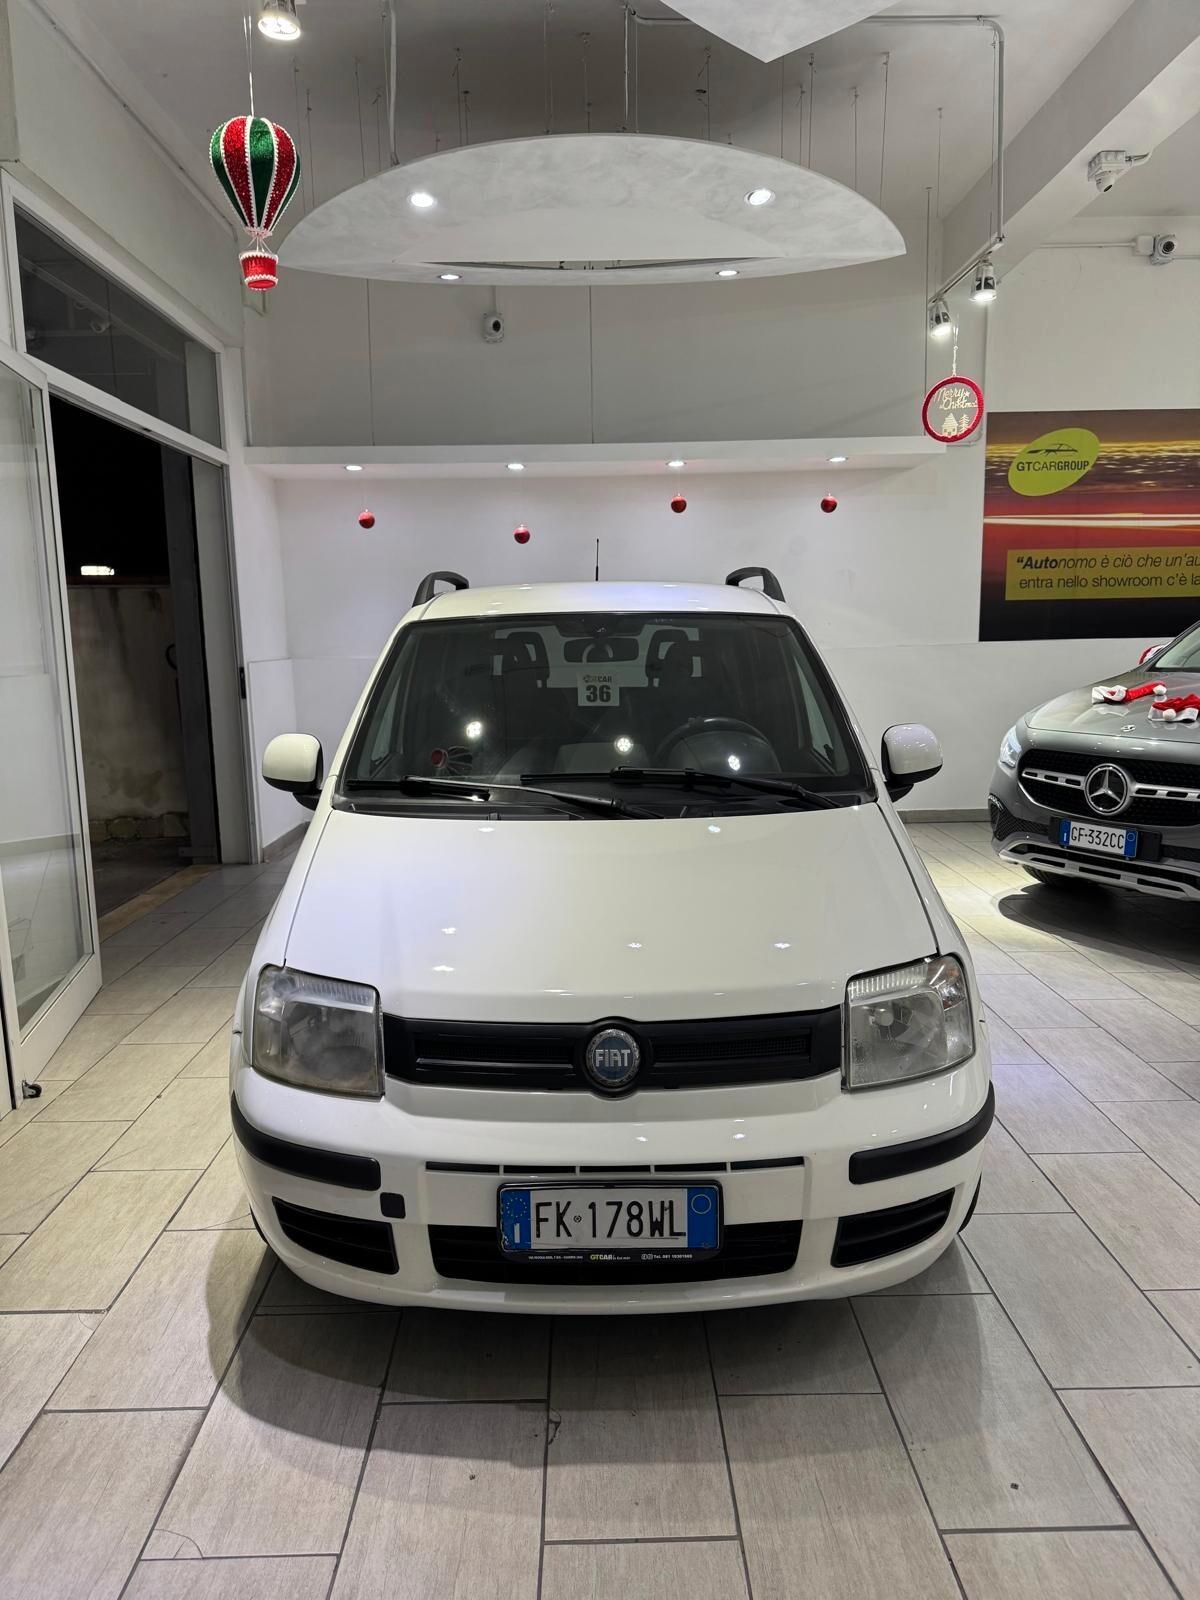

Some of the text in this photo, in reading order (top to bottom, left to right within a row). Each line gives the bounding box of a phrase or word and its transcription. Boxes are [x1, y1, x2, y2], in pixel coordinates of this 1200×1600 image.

[933, 387, 965, 402] Merry
[1016, 461, 1089, 471] GTCARGROUP
[1100, 555, 1109, 567] è
[1113, 554, 1133, 567] ciò
[1137, 553, 1161, 566] che
[1019, 577, 1053, 588] entra
[1057, 575, 1088, 588] nello
[1092, 573, 1162, 587] showroom
[1166, 573, 1187, 585] c'è
[586, 685, 611, 702] 36
[595, 1049, 630, 1067] FIAT
